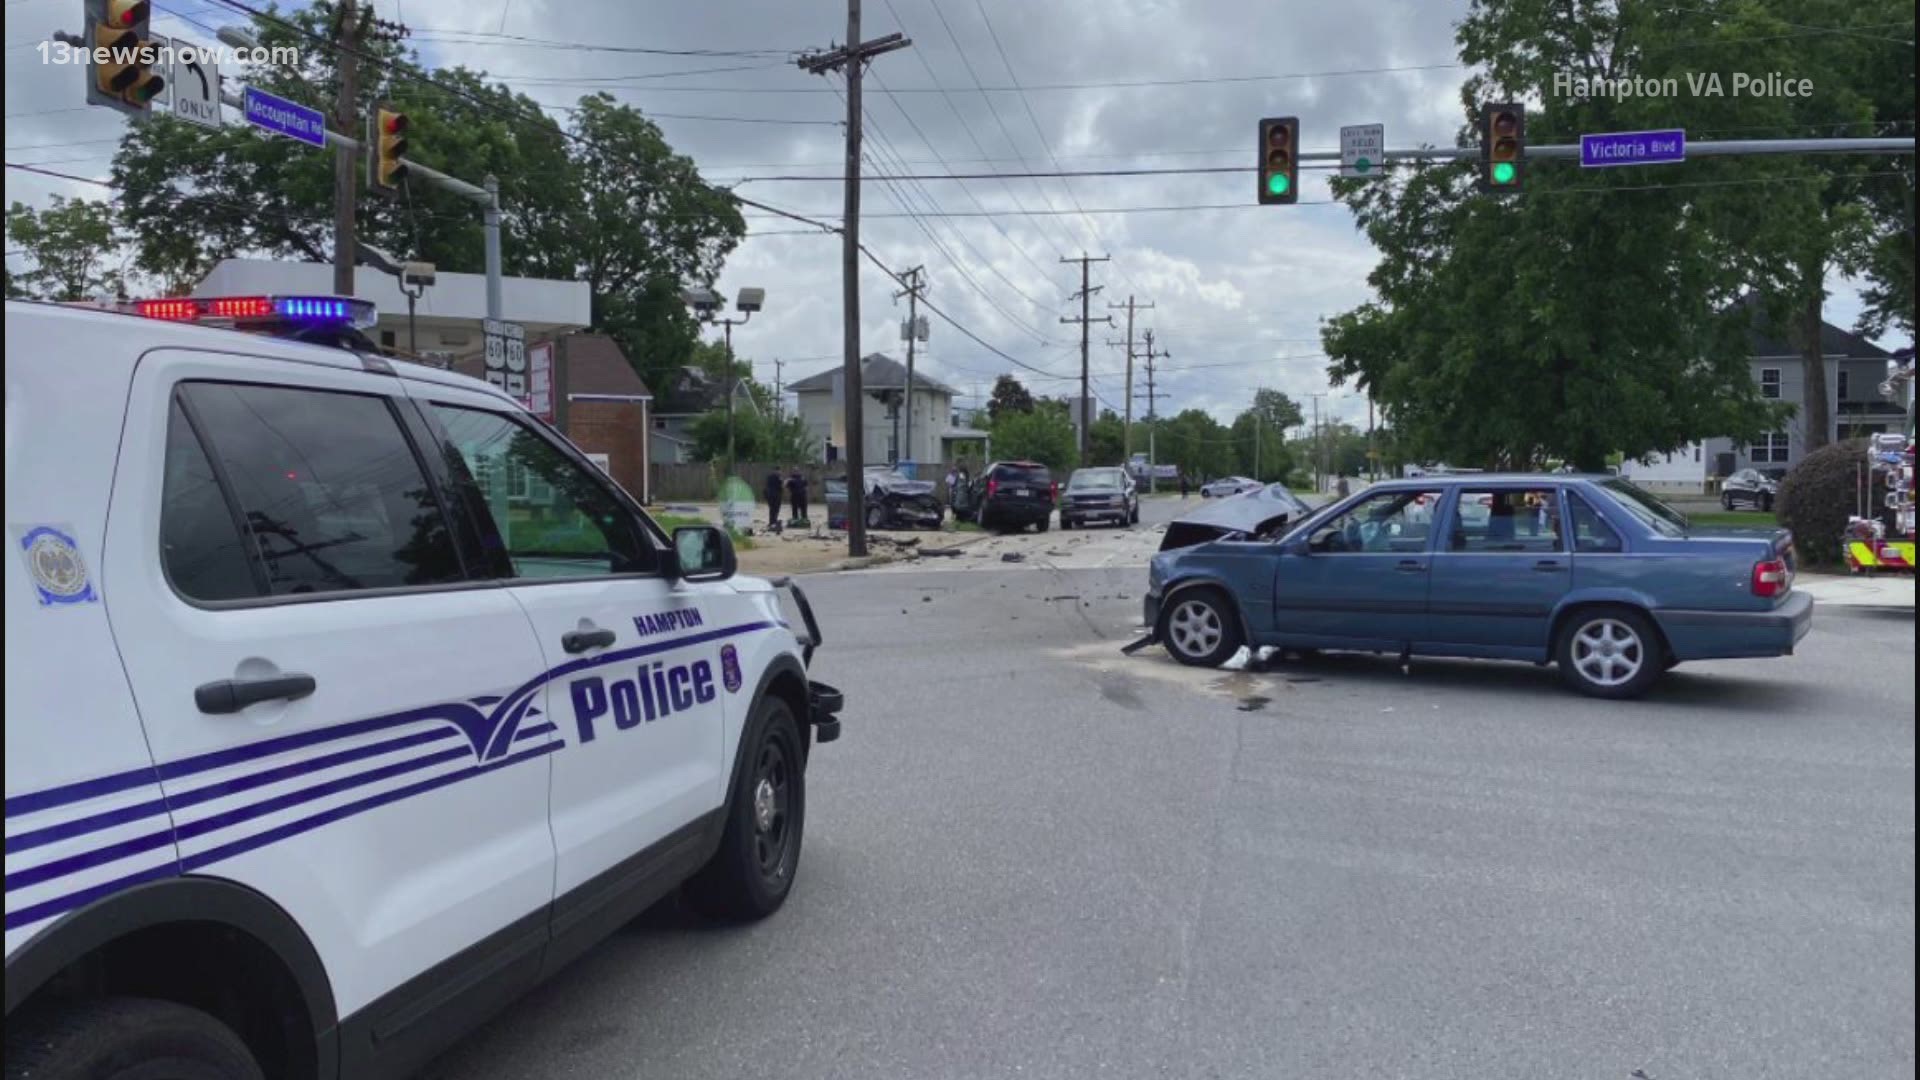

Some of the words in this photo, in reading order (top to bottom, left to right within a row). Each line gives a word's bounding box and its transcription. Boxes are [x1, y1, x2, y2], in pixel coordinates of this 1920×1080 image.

[180, 98, 215, 119] ONLY
[1590, 140, 1646, 159] Victoria
[1650, 140, 1676, 153] Blvd
[633, 607, 704, 637] HAMPTON
[569, 659, 716, 743] Police
